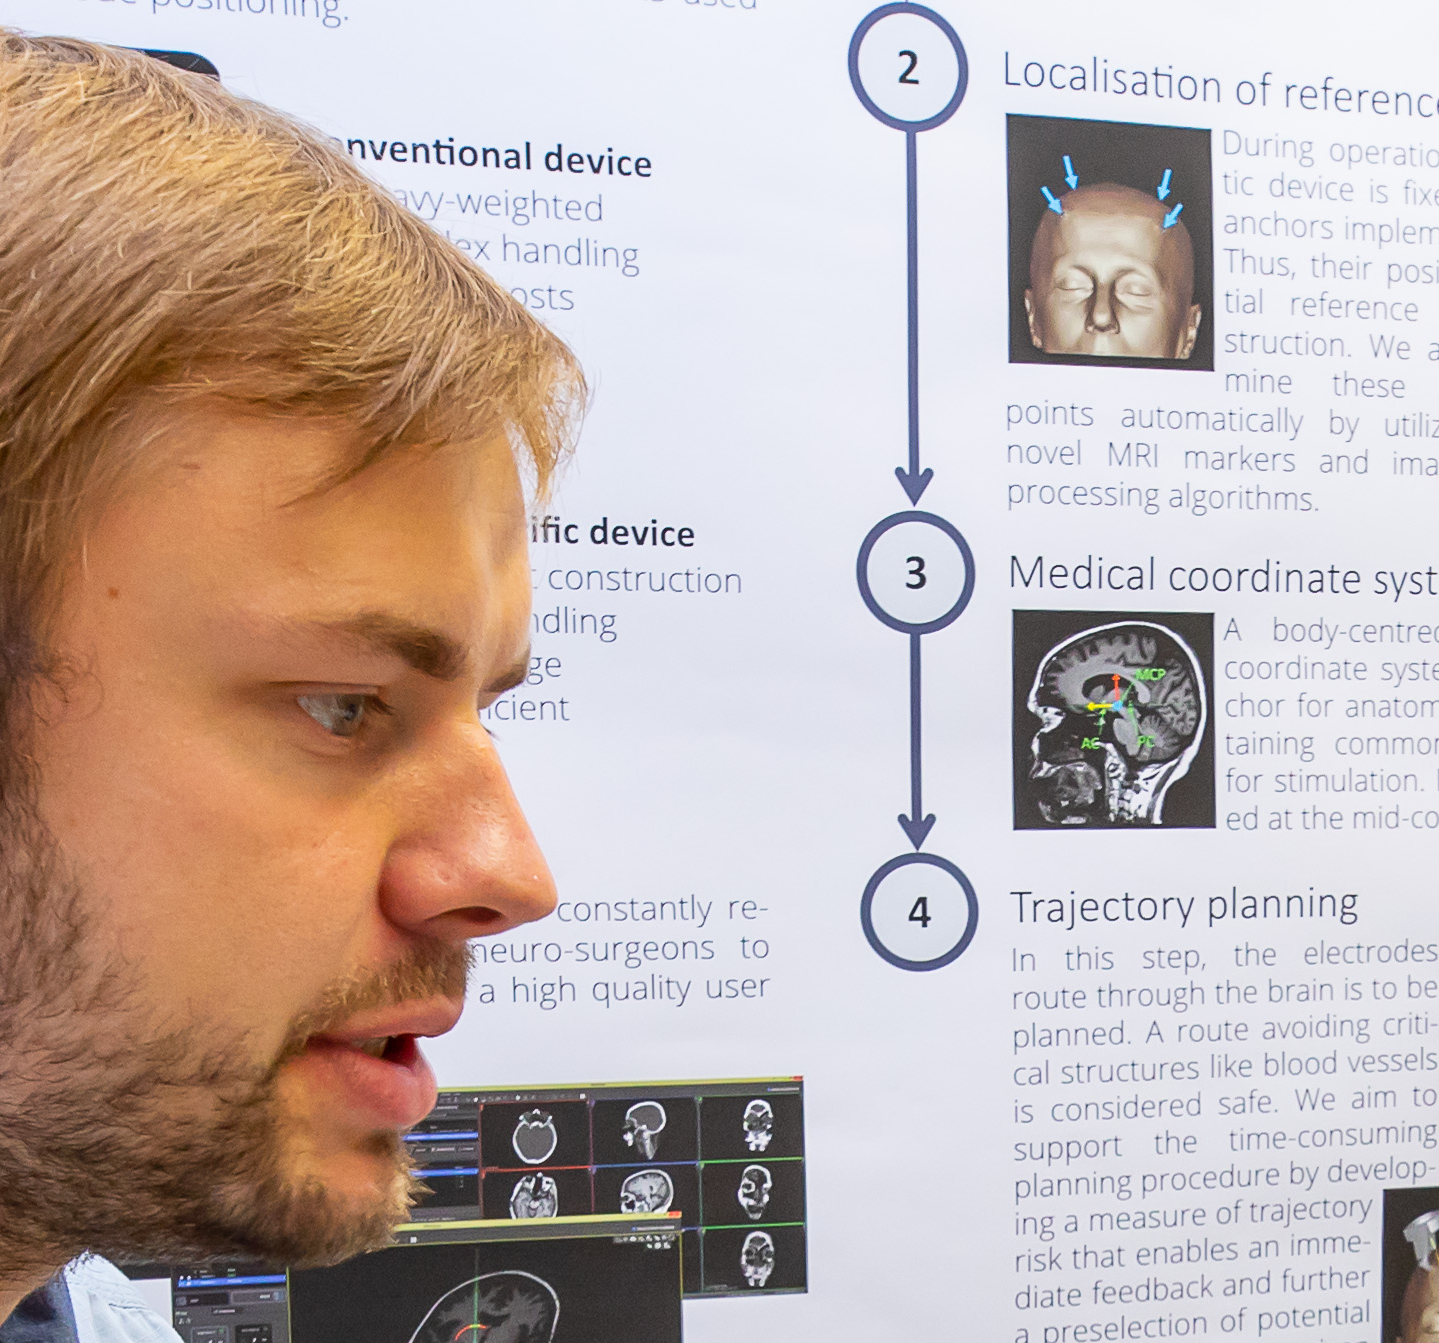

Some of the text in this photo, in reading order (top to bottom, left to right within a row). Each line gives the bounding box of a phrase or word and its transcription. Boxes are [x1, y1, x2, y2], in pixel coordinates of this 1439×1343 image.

[896, 49, 921, 84] 2
[1004, 50, 1221, 104] Localisation
[1235, 71, 1274, 107] of
[341, 136, 653, 178] nventional device
[1223, 129, 1315, 168] During
[1222, 169, 1254, 197] tic
[1268, 171, 1354, 202] device
[1370, 178, 1389, 204] is
[1223, 210, 1334, 240] anchors
[502, 233, 640, 278] handling
[1222, 247, 1296, 281] Thus,
[1310, 251, 1373, 281] their
[1223, 287, 1264, 315] tial
[1290, 290, 1419, 322] reference
[590, 517, 695, 547] device
[548, 566, 743, 594] construction
[905, 555, 928, 592] 3
[1010, 553, 1155, 591] Medical
[1168, 557, 1362, 595] coordinate
[1222, 616, 1243, 642] A
[1224, 654, 1368, 681] coordinate
[1224, 691, 1286, 718] chor
[1296, 691, 1335, 718] for
[556, 894, 769, 928] constantly re-
[907, 895, 932, 930] 4
[1008, 885, 1359, 932] Trajectory planning
[469, 936, 769, 970] neuro-surgeons to
[1012, 937, 1439, 976] In this step, the electrodes
[479, 973, 771, 1011] a high quality user
[1012, 973, 1438, 1014] route through the brain is to be
[1013, 1010, 1439, 1055] planned. A route avoiding criti-
[1013, 1046, 1439, 1087] cal structures like blood vessels
